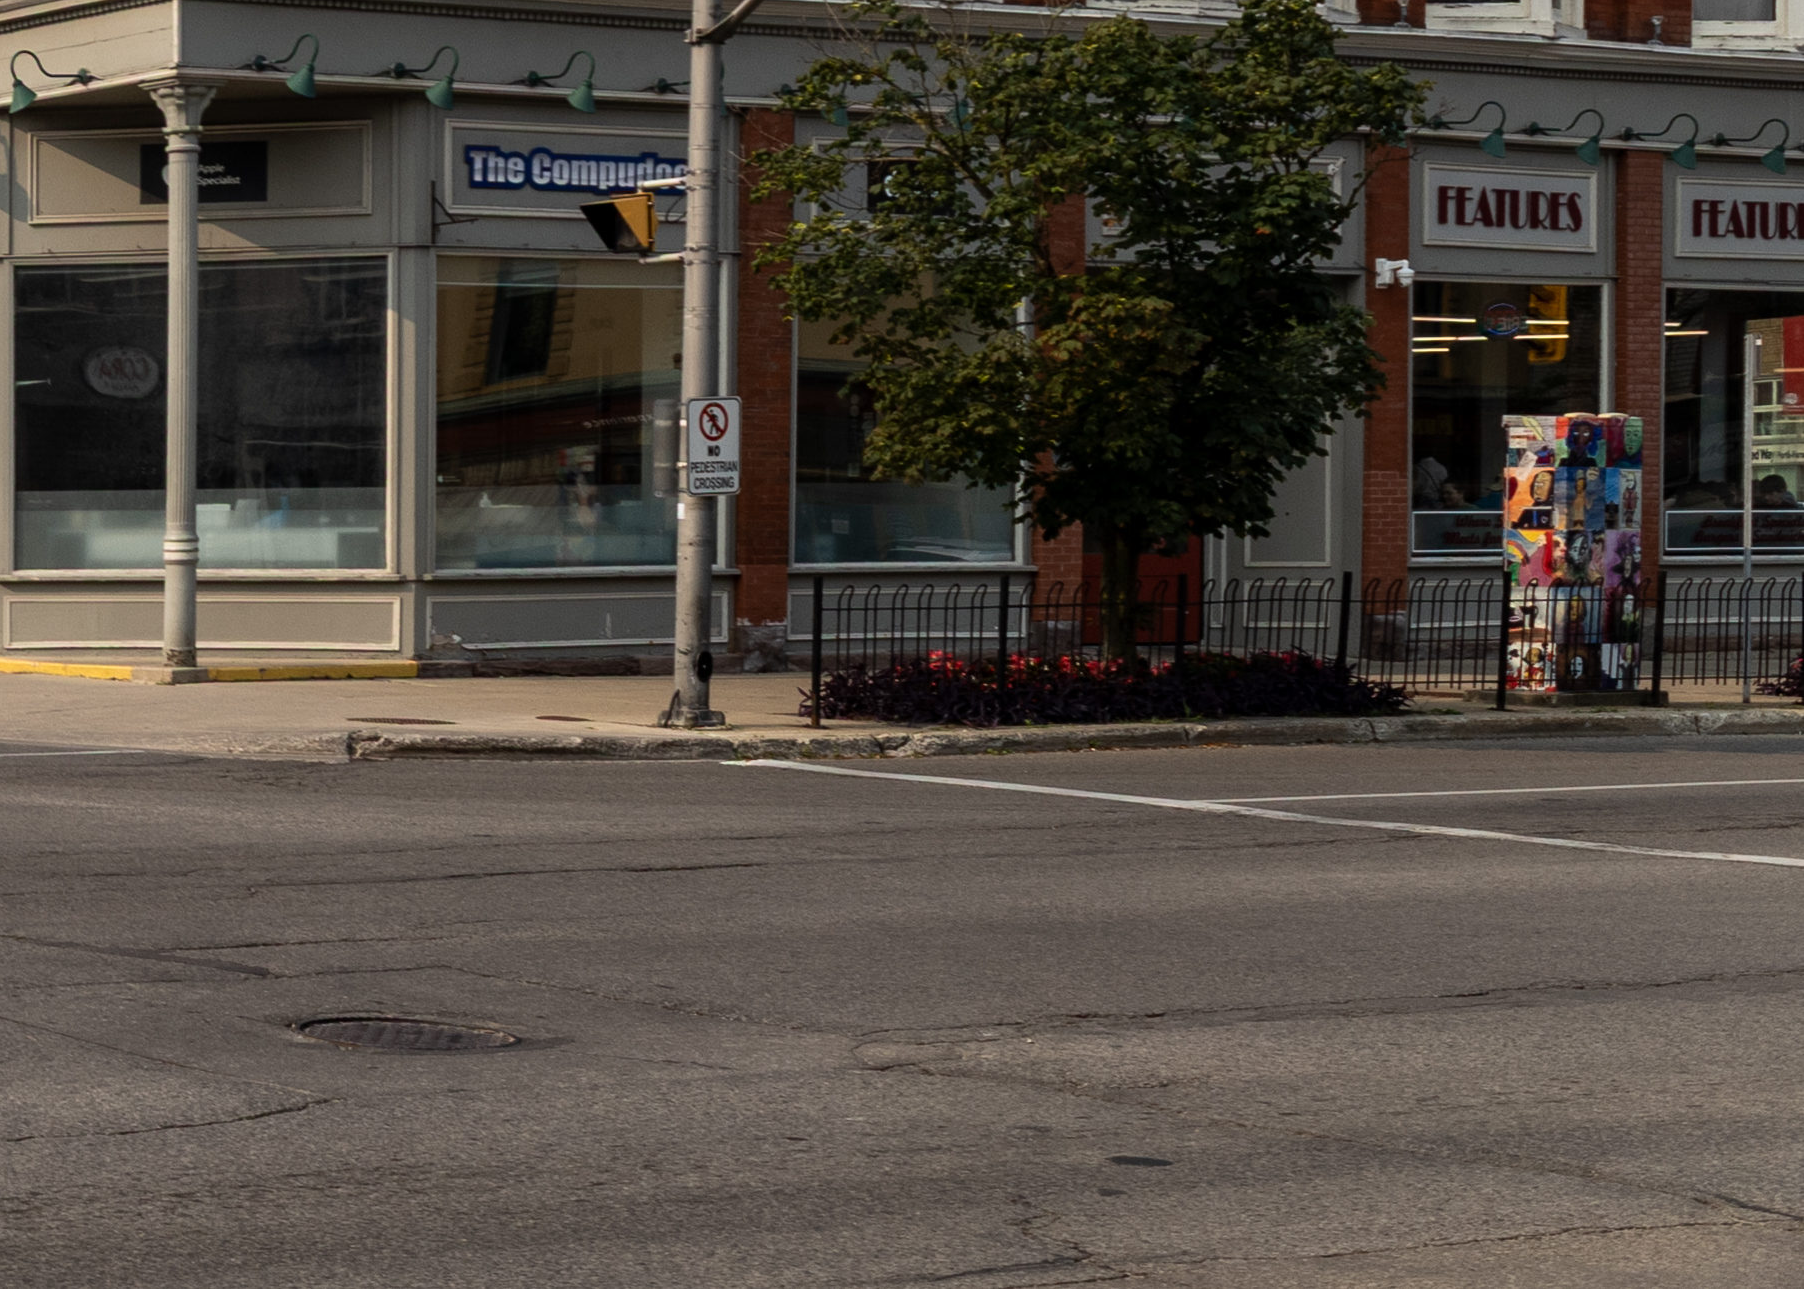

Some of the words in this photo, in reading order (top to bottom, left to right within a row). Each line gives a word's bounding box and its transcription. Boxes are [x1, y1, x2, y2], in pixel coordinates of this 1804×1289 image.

[469, 150, 525, 184] The
[1437, 185, 1583, 233] FEATURES
[707, 445, 721, 457] NO
[690, 461, 738, 474] PEDESTRIAN
[693, 476, 735, 489] CROSSING
